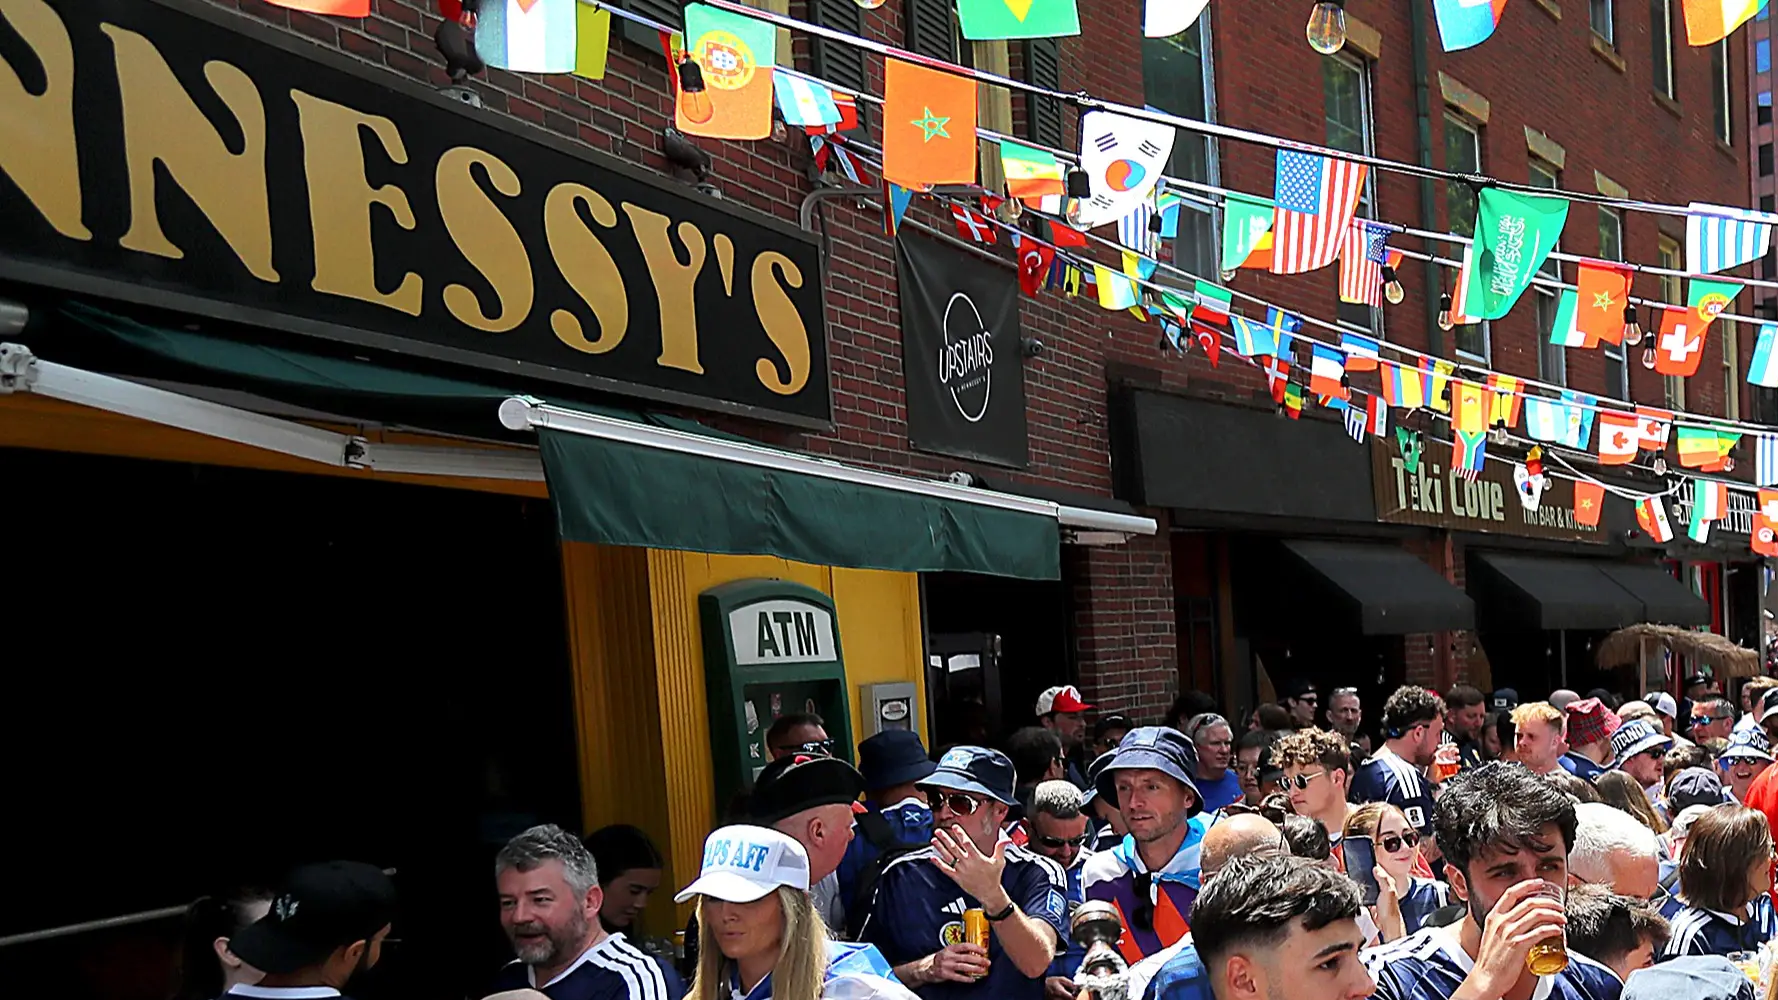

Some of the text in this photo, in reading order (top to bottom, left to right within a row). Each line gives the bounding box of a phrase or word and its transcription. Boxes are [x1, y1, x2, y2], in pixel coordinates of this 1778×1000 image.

[940, 331, 993, 384] UPSTAIRS
[1450, 470, 1505, 522] Cove
[1539, 505, 1556, 527] BAR
[1557, 507, 1565, 528] &
[758, 612, 820, 657] ATM
[730, 840, 769, 871] AFF
